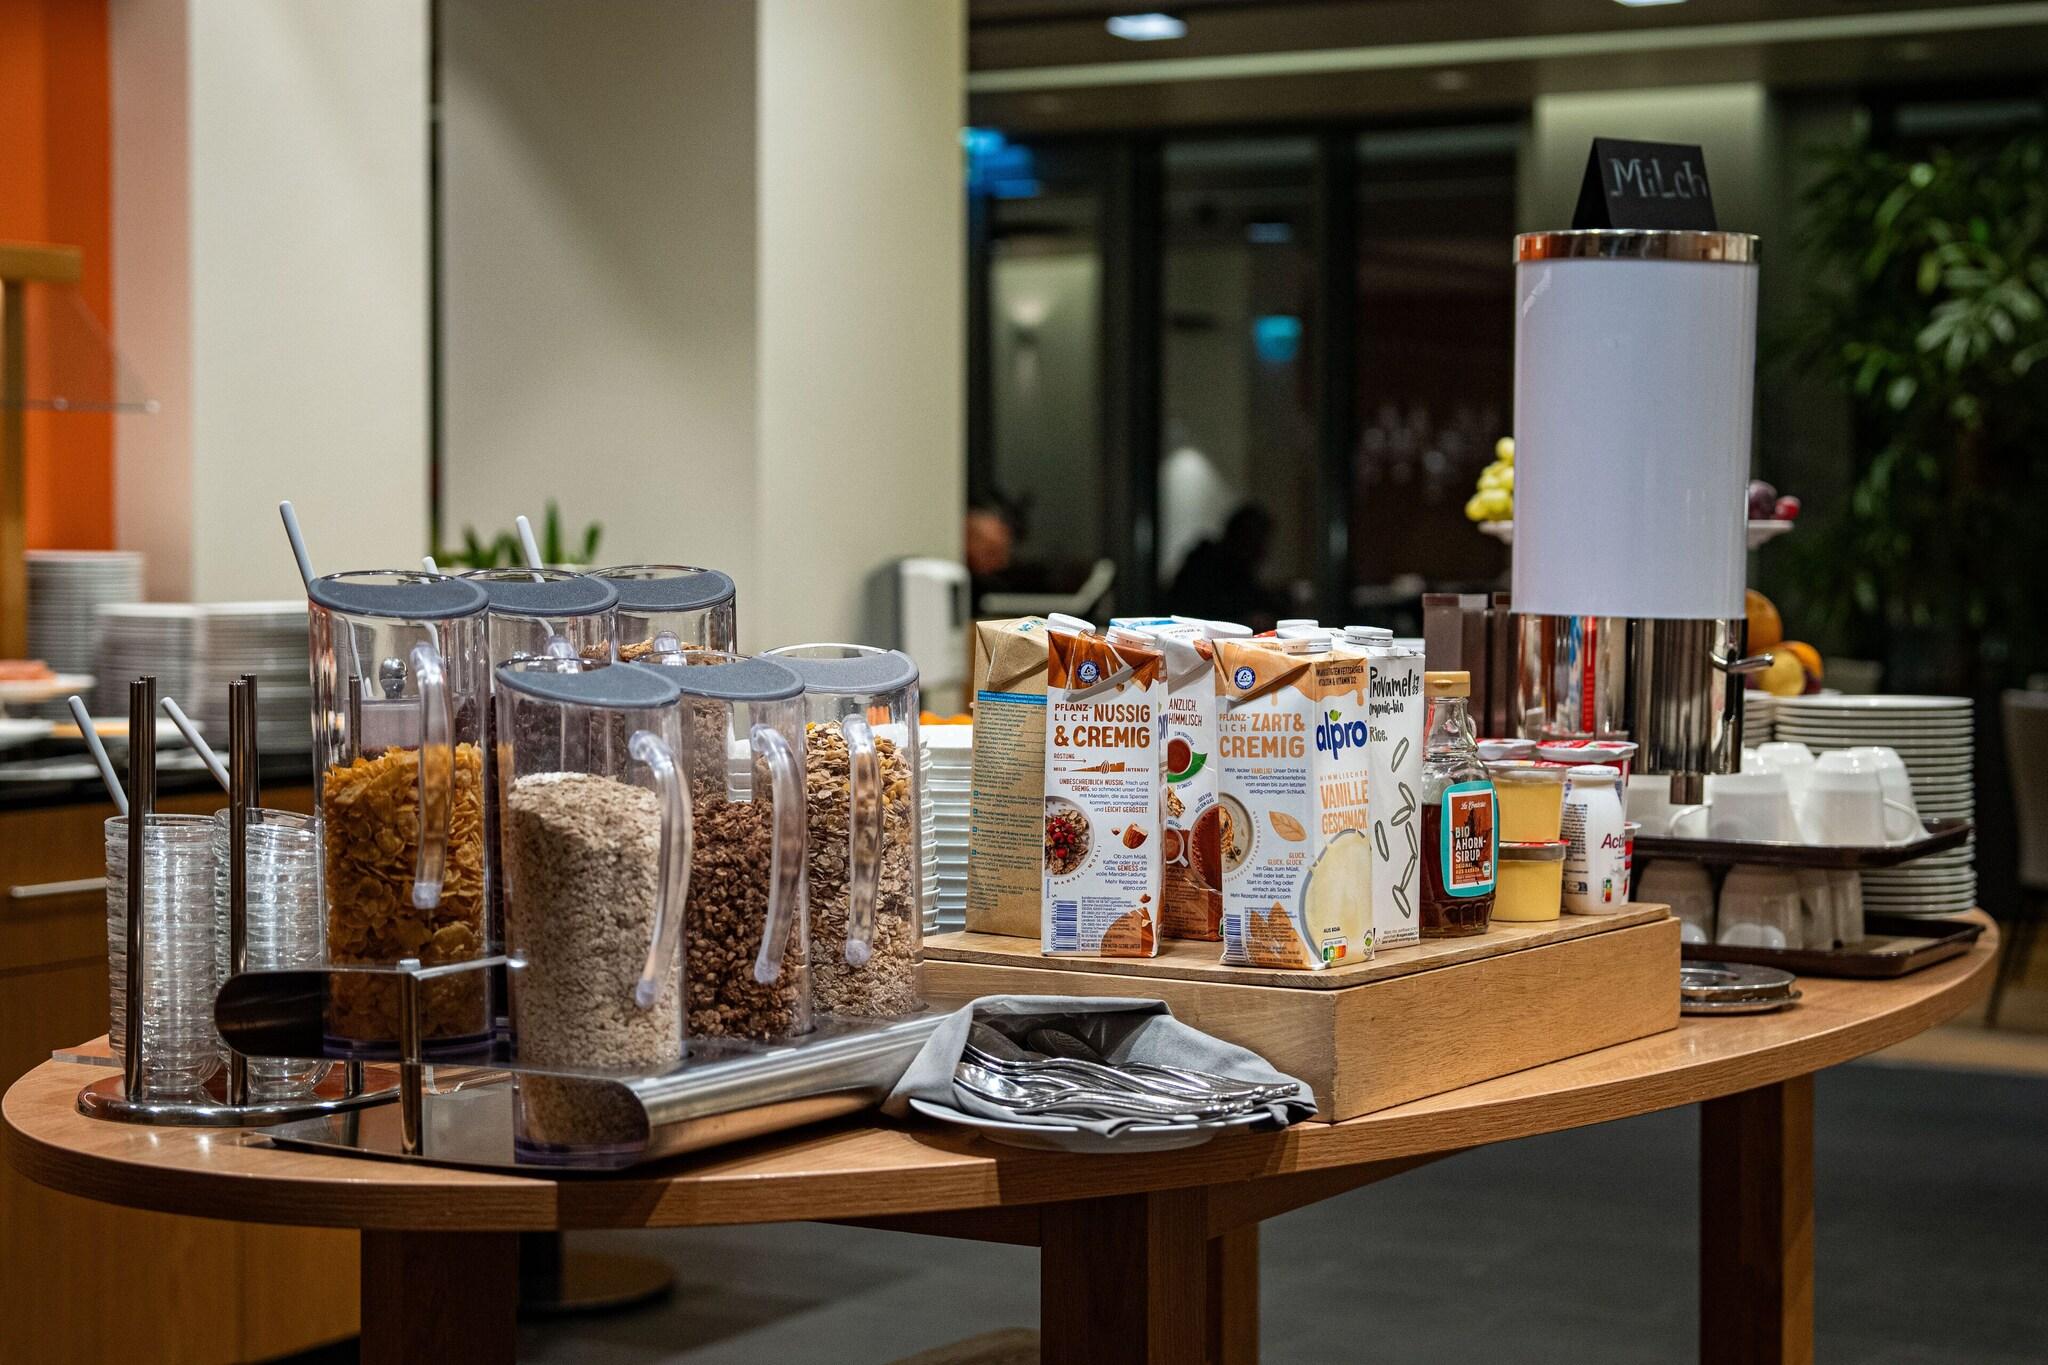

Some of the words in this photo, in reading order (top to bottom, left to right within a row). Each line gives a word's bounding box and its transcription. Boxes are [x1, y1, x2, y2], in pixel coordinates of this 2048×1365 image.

[1094, 704, 1150, 723] NUSSIG
[1219, 713, 1250, 721] PFLANZ-
[1054, 725, 1069, 747] &
[1073, 725, 1150, 748] CREMIG
[1219, 724, 1246, 732] LICH
[1316, 712, 1367, 760] alpro
[1220, 736, 1305, 758] CREMIG
[1320, 780, 1368, 809] VANILLE
[1322, 808, 1367, 834] GESCHMACK
[1455, 826, 1470, 838] BIO
[1455, 836, 1486, 851] AHORN-
[1455, 849, 1481, 863] SIRUP
